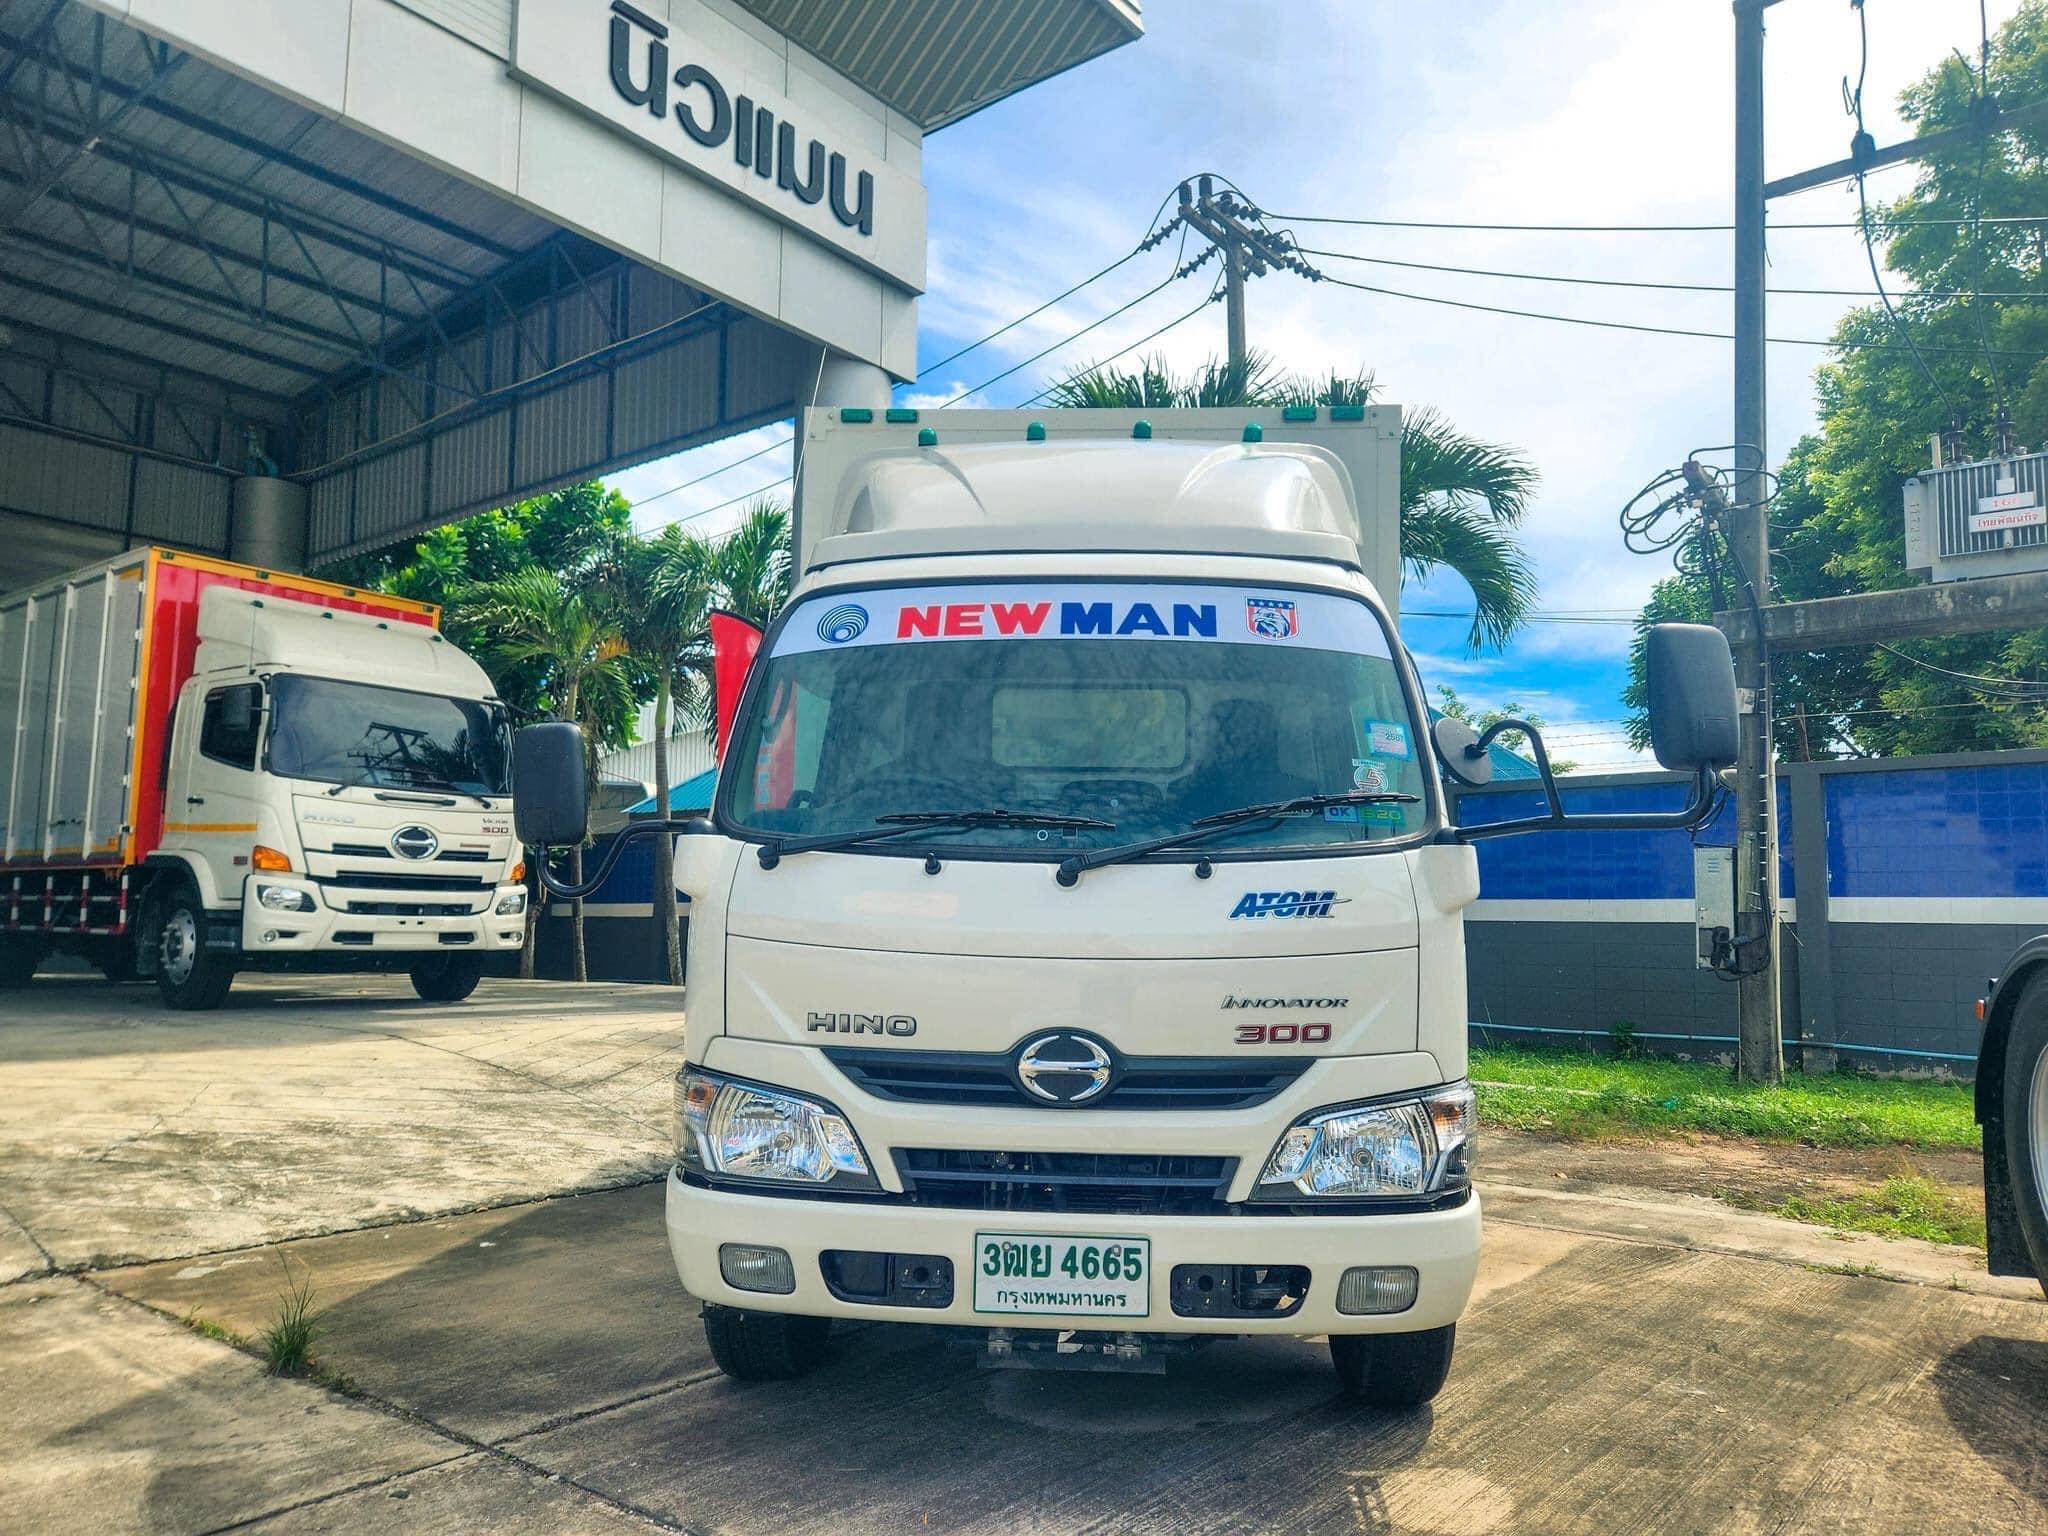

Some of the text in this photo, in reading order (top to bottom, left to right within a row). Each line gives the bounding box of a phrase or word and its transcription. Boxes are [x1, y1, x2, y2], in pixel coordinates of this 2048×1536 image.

[610, 0, 875, 236] นิวแมน
[1329, 806, 1350, 817] OK
[481, 826, 510, 834] 500
[1229, 891, 1337, 919] ATOM
[807, 1012, 917, 1037] HINO
[1233, 1022, 1333, 1045] 300
[1061, 1245, 1143, 1281] 4665
[997, 1289, 1127, 1310] กรุงเทพมหานคร
